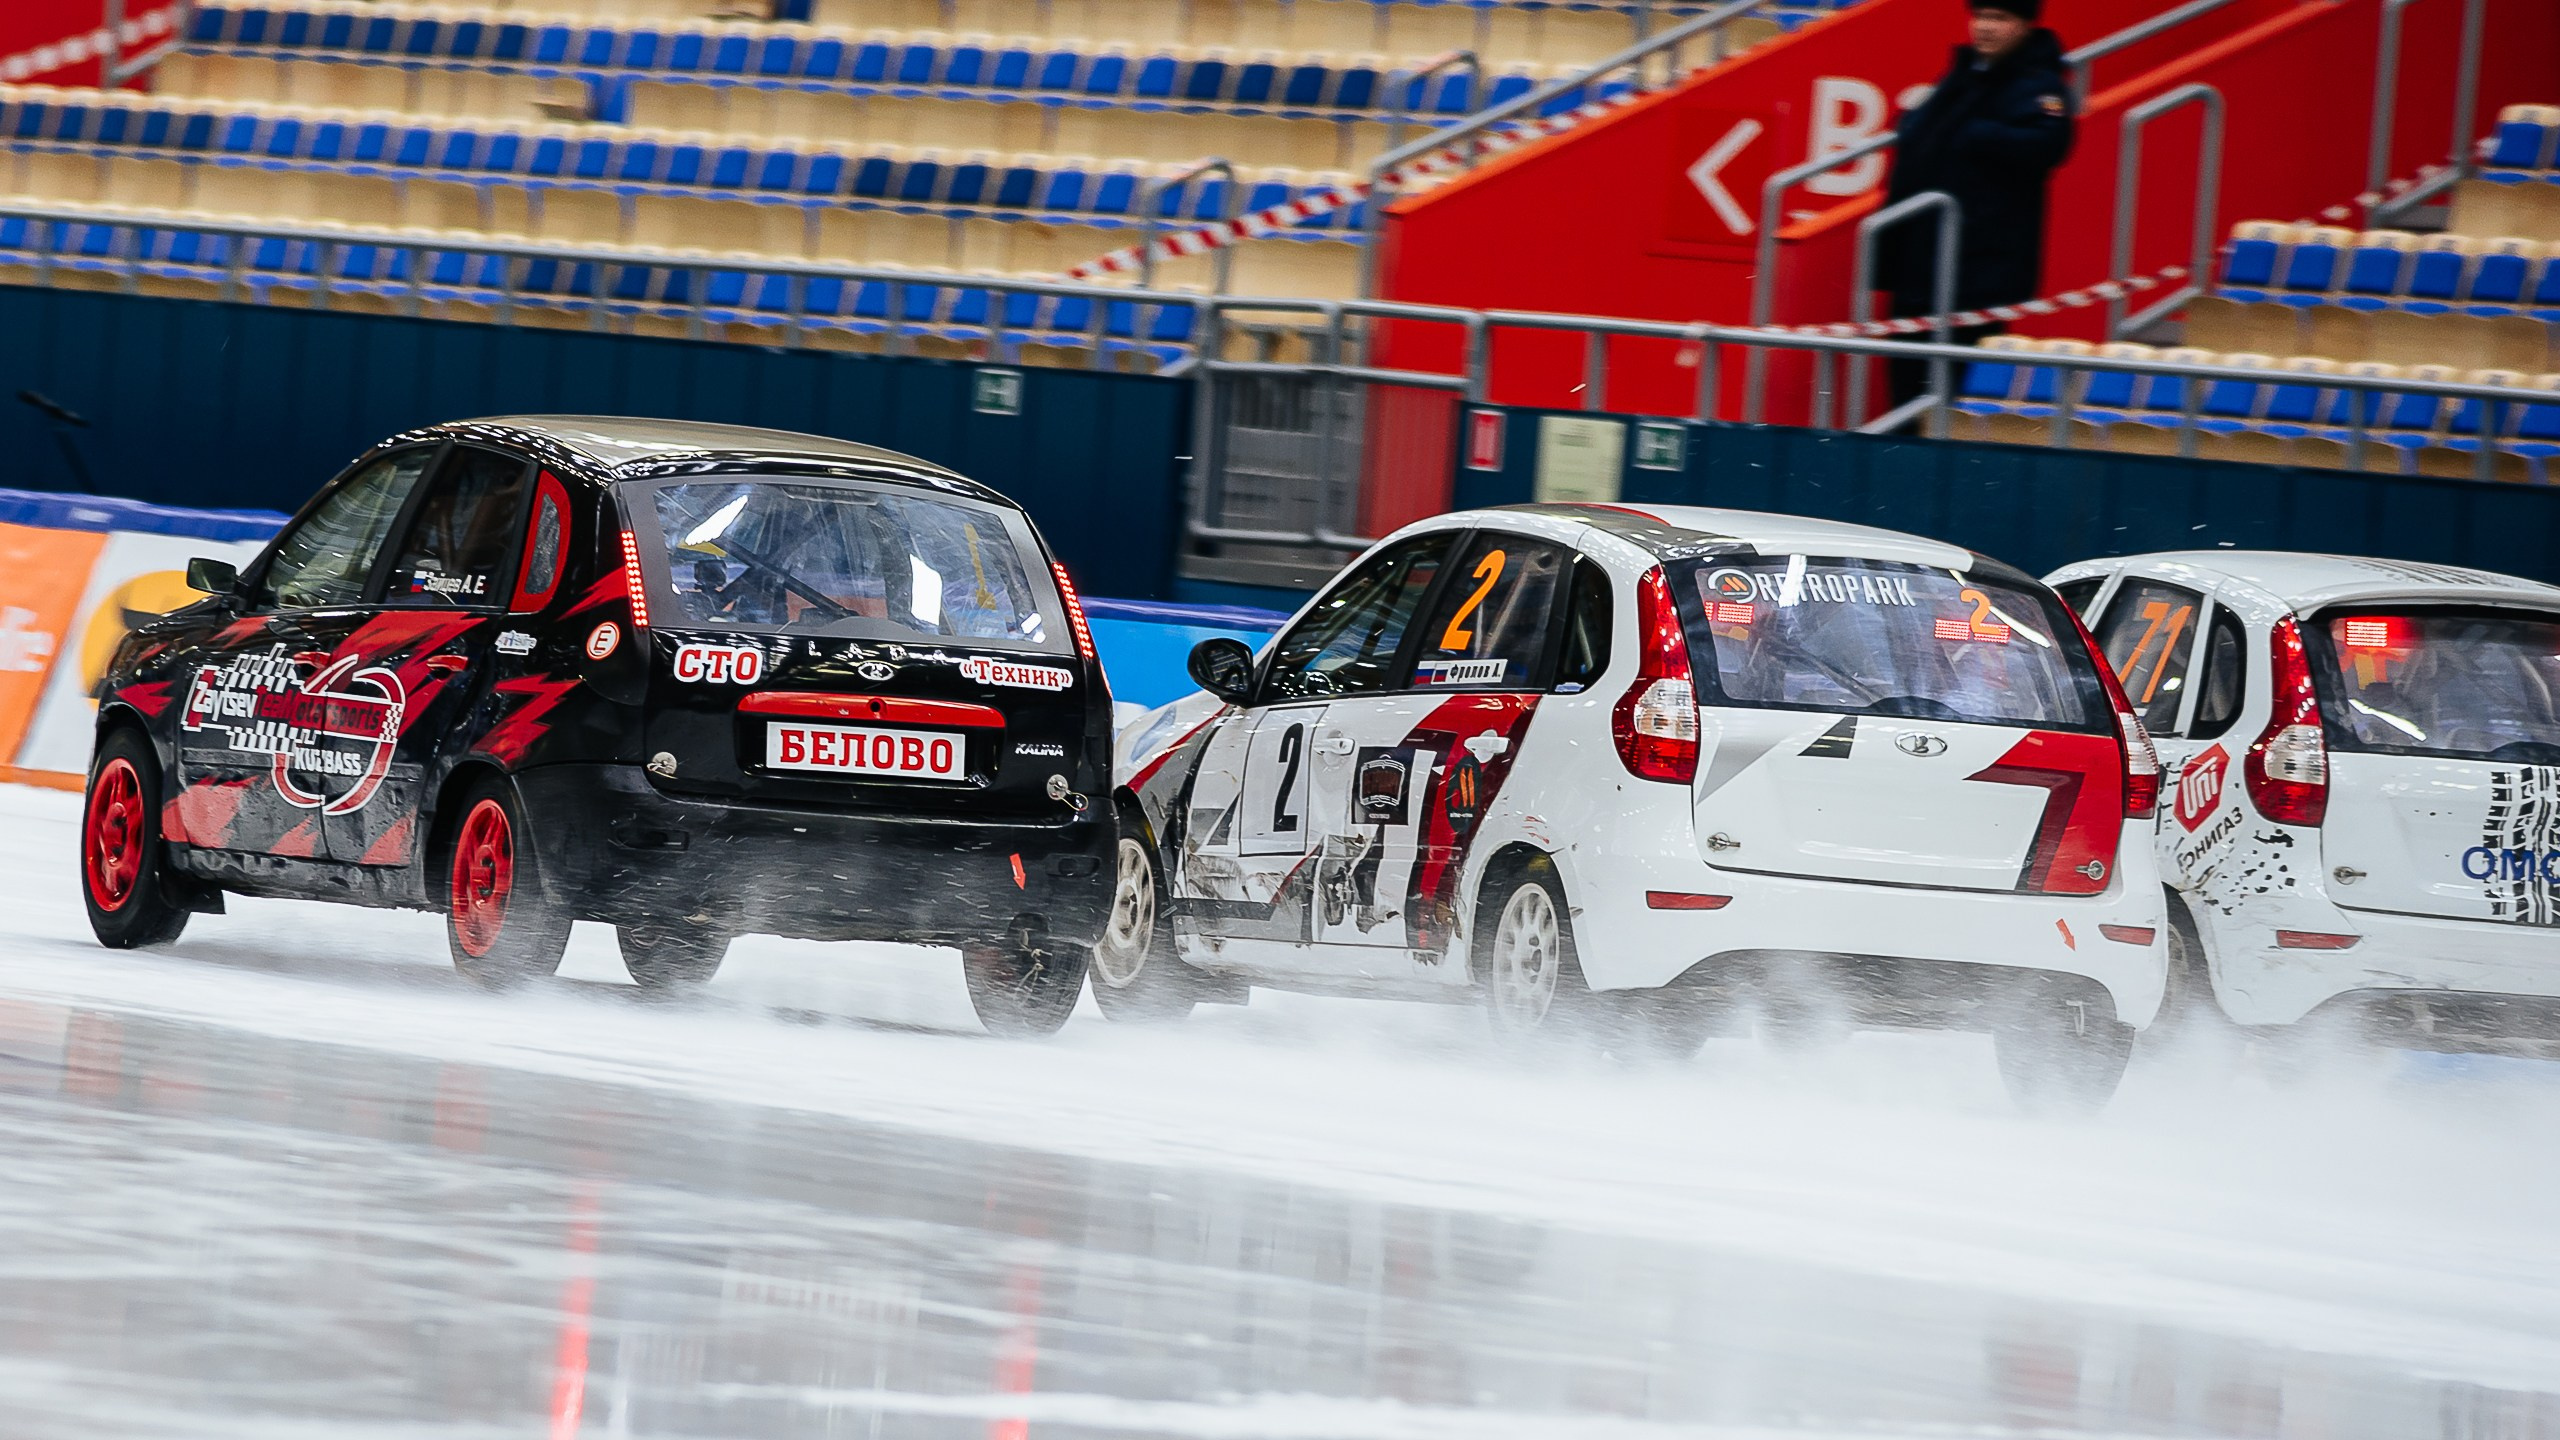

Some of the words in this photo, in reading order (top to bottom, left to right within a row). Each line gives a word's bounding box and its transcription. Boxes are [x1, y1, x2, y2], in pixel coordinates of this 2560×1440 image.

[1440, 549, 1506, 650] 2
[1960, 587, 2001, 635] 2
[594, 629, 612, 651] E
[2118, 601, 2192, 703] 71
[679, 648, 759, 682] СТО
[962, 660, 1071, 688] «Техник»
[1450, 663, 1490, 683] Фролов
[779, 728, 953, 775] БЕЛОВО
[1015, 742, 1064, 757] KALINA
[1273, 722, 1304, 832] 2
